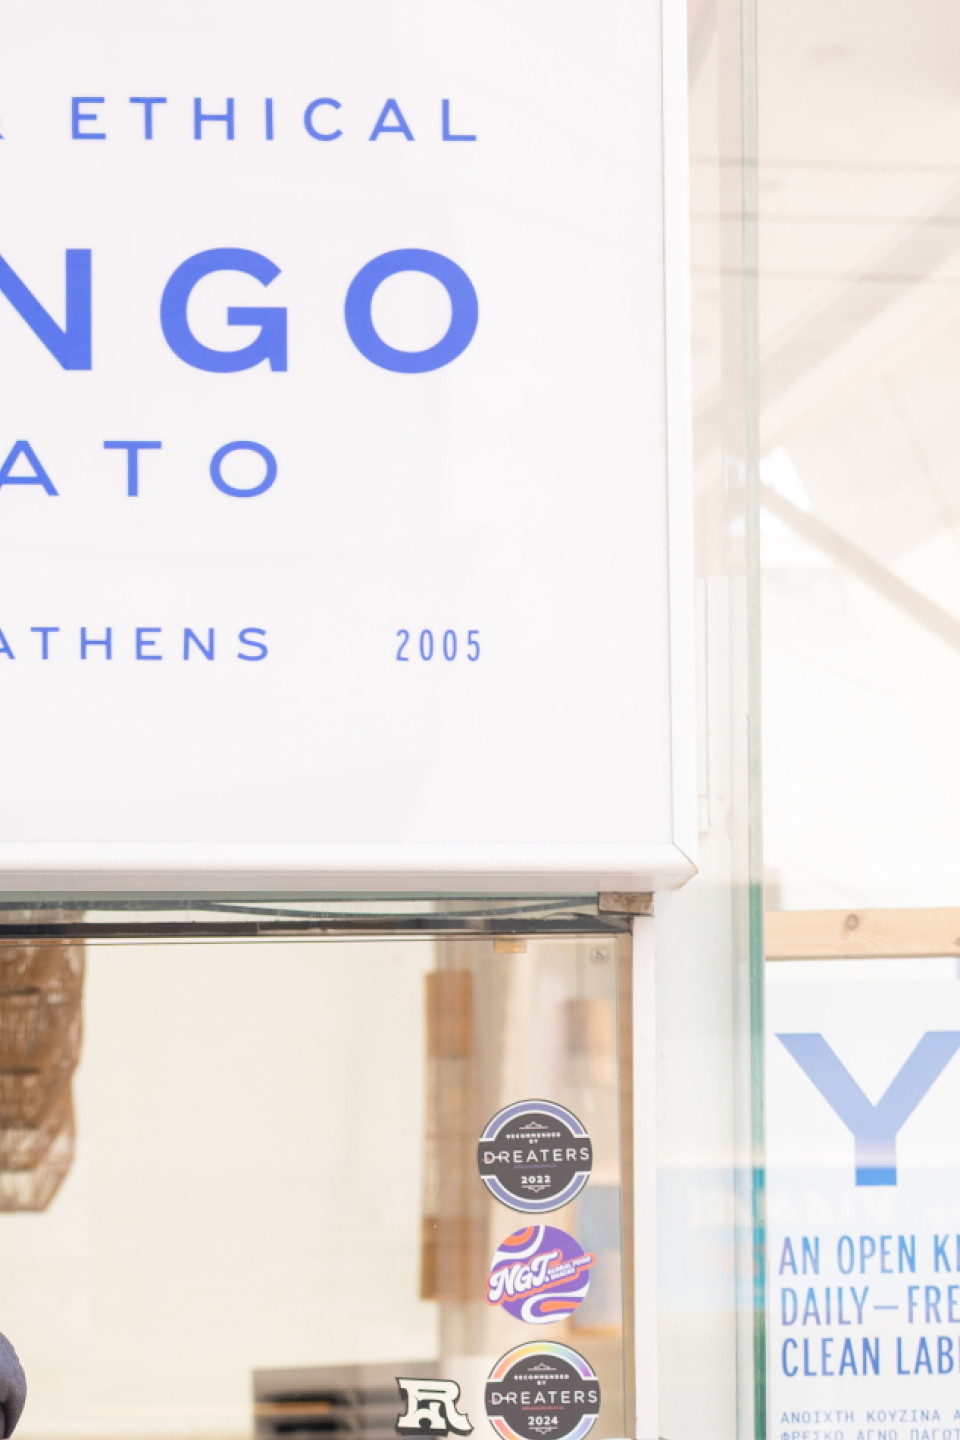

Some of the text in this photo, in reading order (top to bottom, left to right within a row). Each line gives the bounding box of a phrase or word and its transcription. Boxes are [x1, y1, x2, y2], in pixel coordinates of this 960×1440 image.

[70, 97, 478, 143] ETHICAL
[394, 628, 483, 663] 2005
[774, 1030, 960, 1186] Y
[521, 1175, 551, 1184] 2022
[778, 1236, 820, 1275] AN
[837, 1235, 916, 1274] OPEN
[781, 1336, 960, 1377] CLEAN LAB
[527, 1416, 558, 1426] 2024
[780, 1410, 854, 1424] ΑΝΟΙΧΤΗ
[866, 1408, 941, 1423] ΚΟΥΖΙΝΑ
